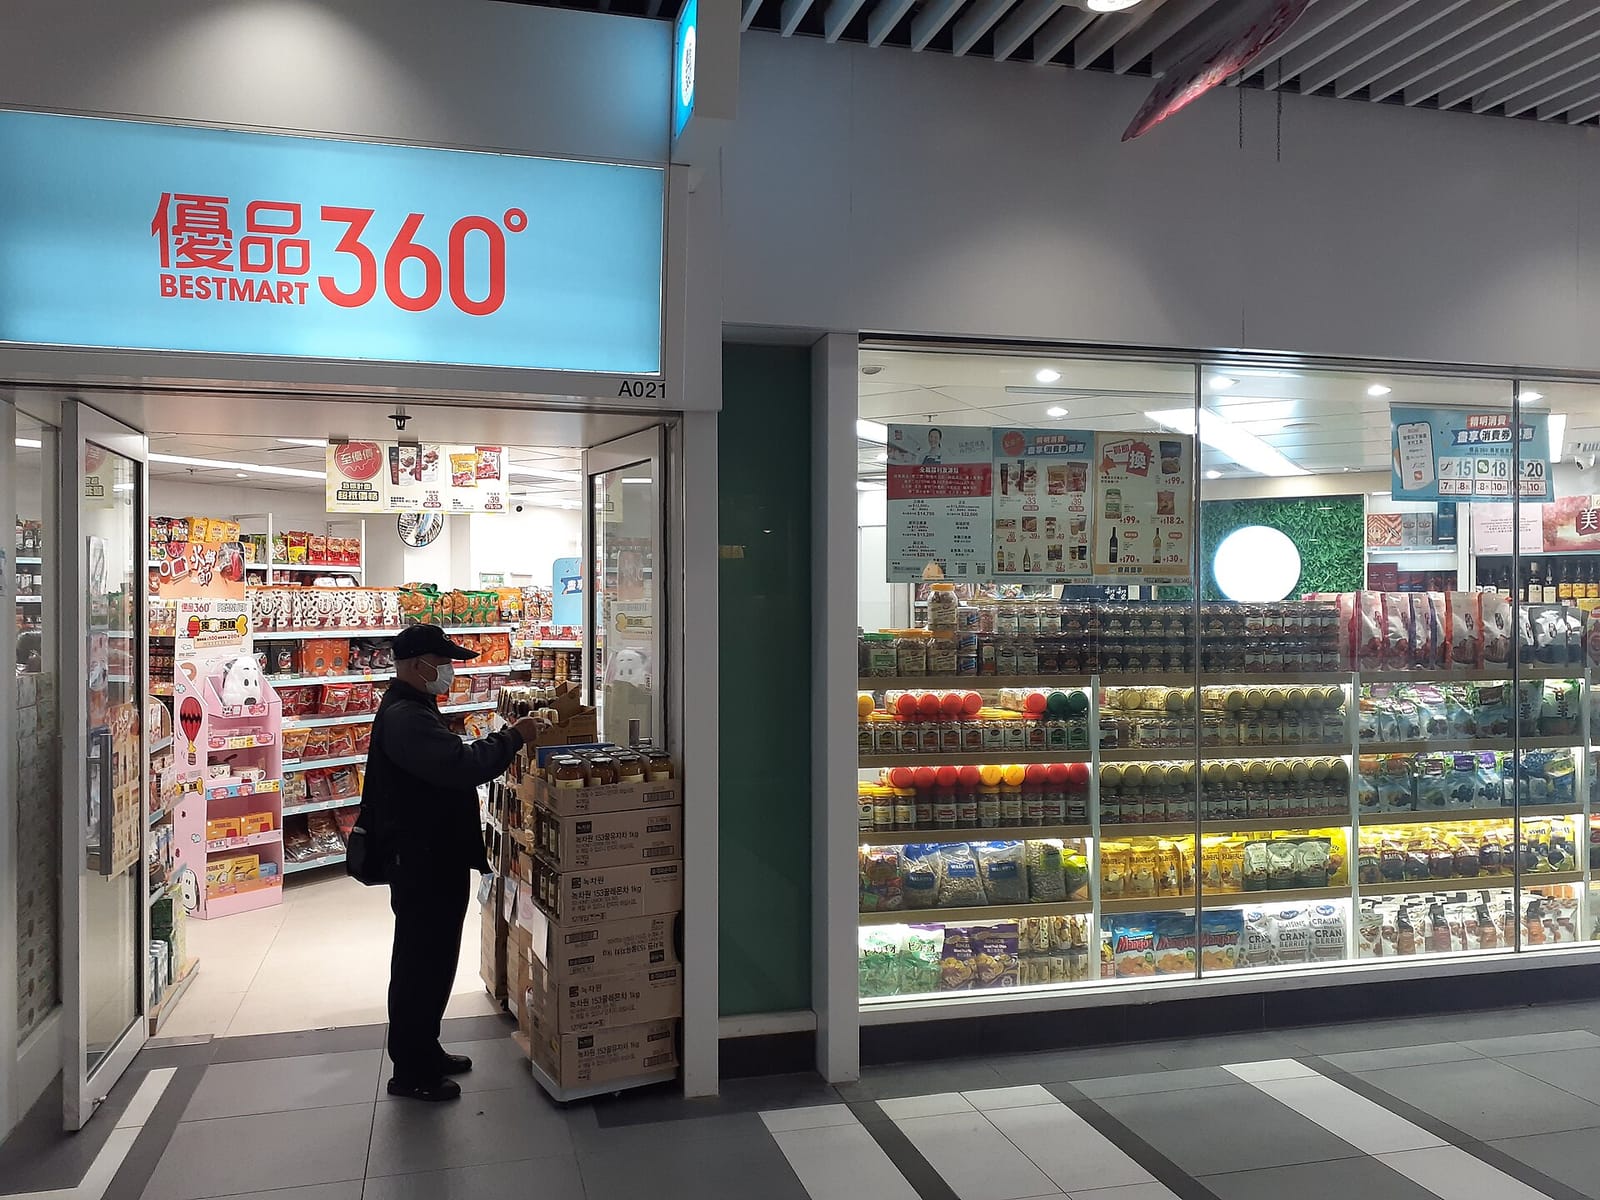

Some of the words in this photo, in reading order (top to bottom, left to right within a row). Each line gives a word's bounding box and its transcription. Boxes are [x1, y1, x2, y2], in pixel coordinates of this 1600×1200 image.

[151, 191, 311, 276] 優品
[159, 273, 310, 305] BESTMART
[617, 380, 667, 399] A021
[1580, 507, 1599, 531] 美
